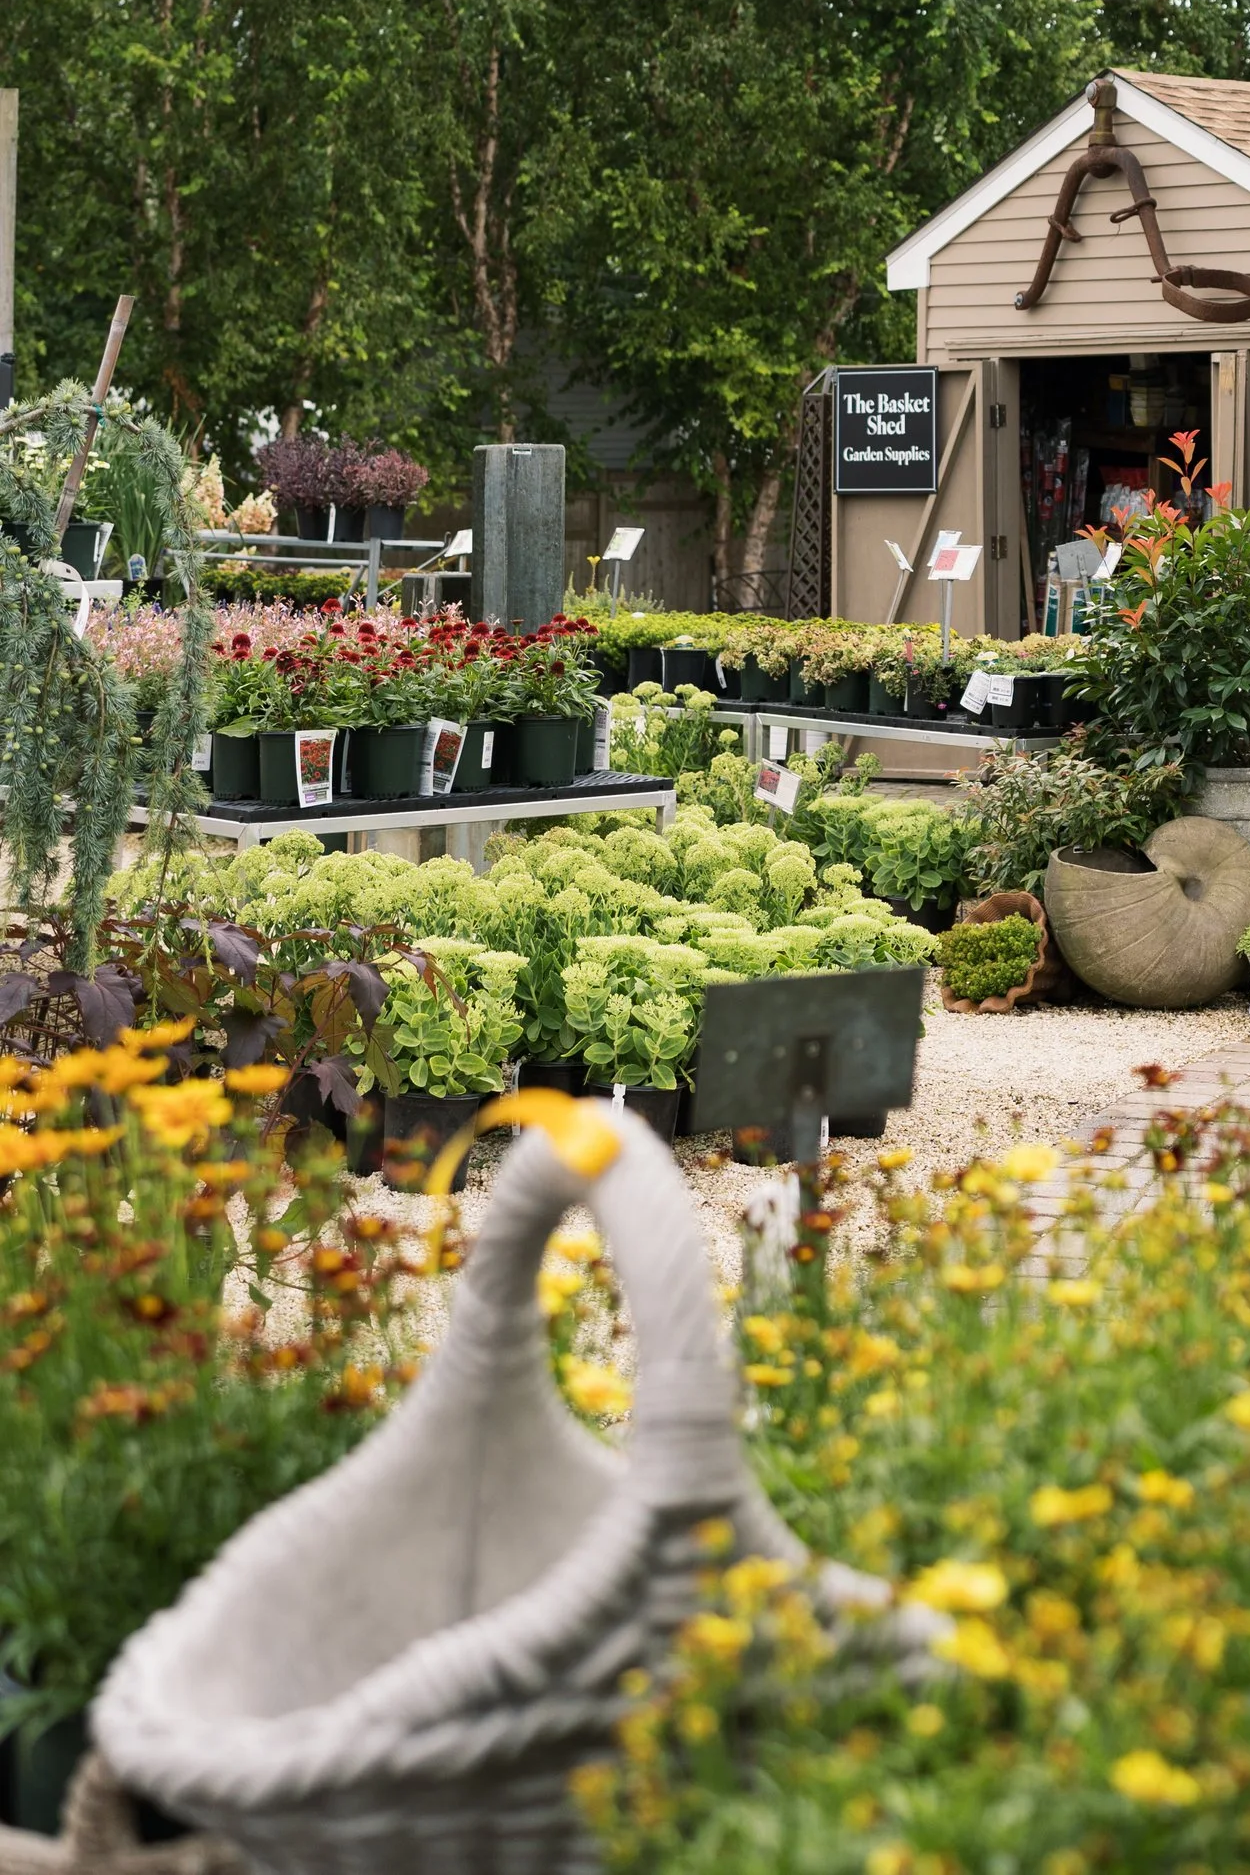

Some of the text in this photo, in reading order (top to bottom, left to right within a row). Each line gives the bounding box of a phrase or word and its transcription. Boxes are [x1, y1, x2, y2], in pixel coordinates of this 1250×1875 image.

[843, 392, 931, 414] The Basket
[866, 414, 906, 436] Shed
[843, 445, 930, 466] Garden Supplies
